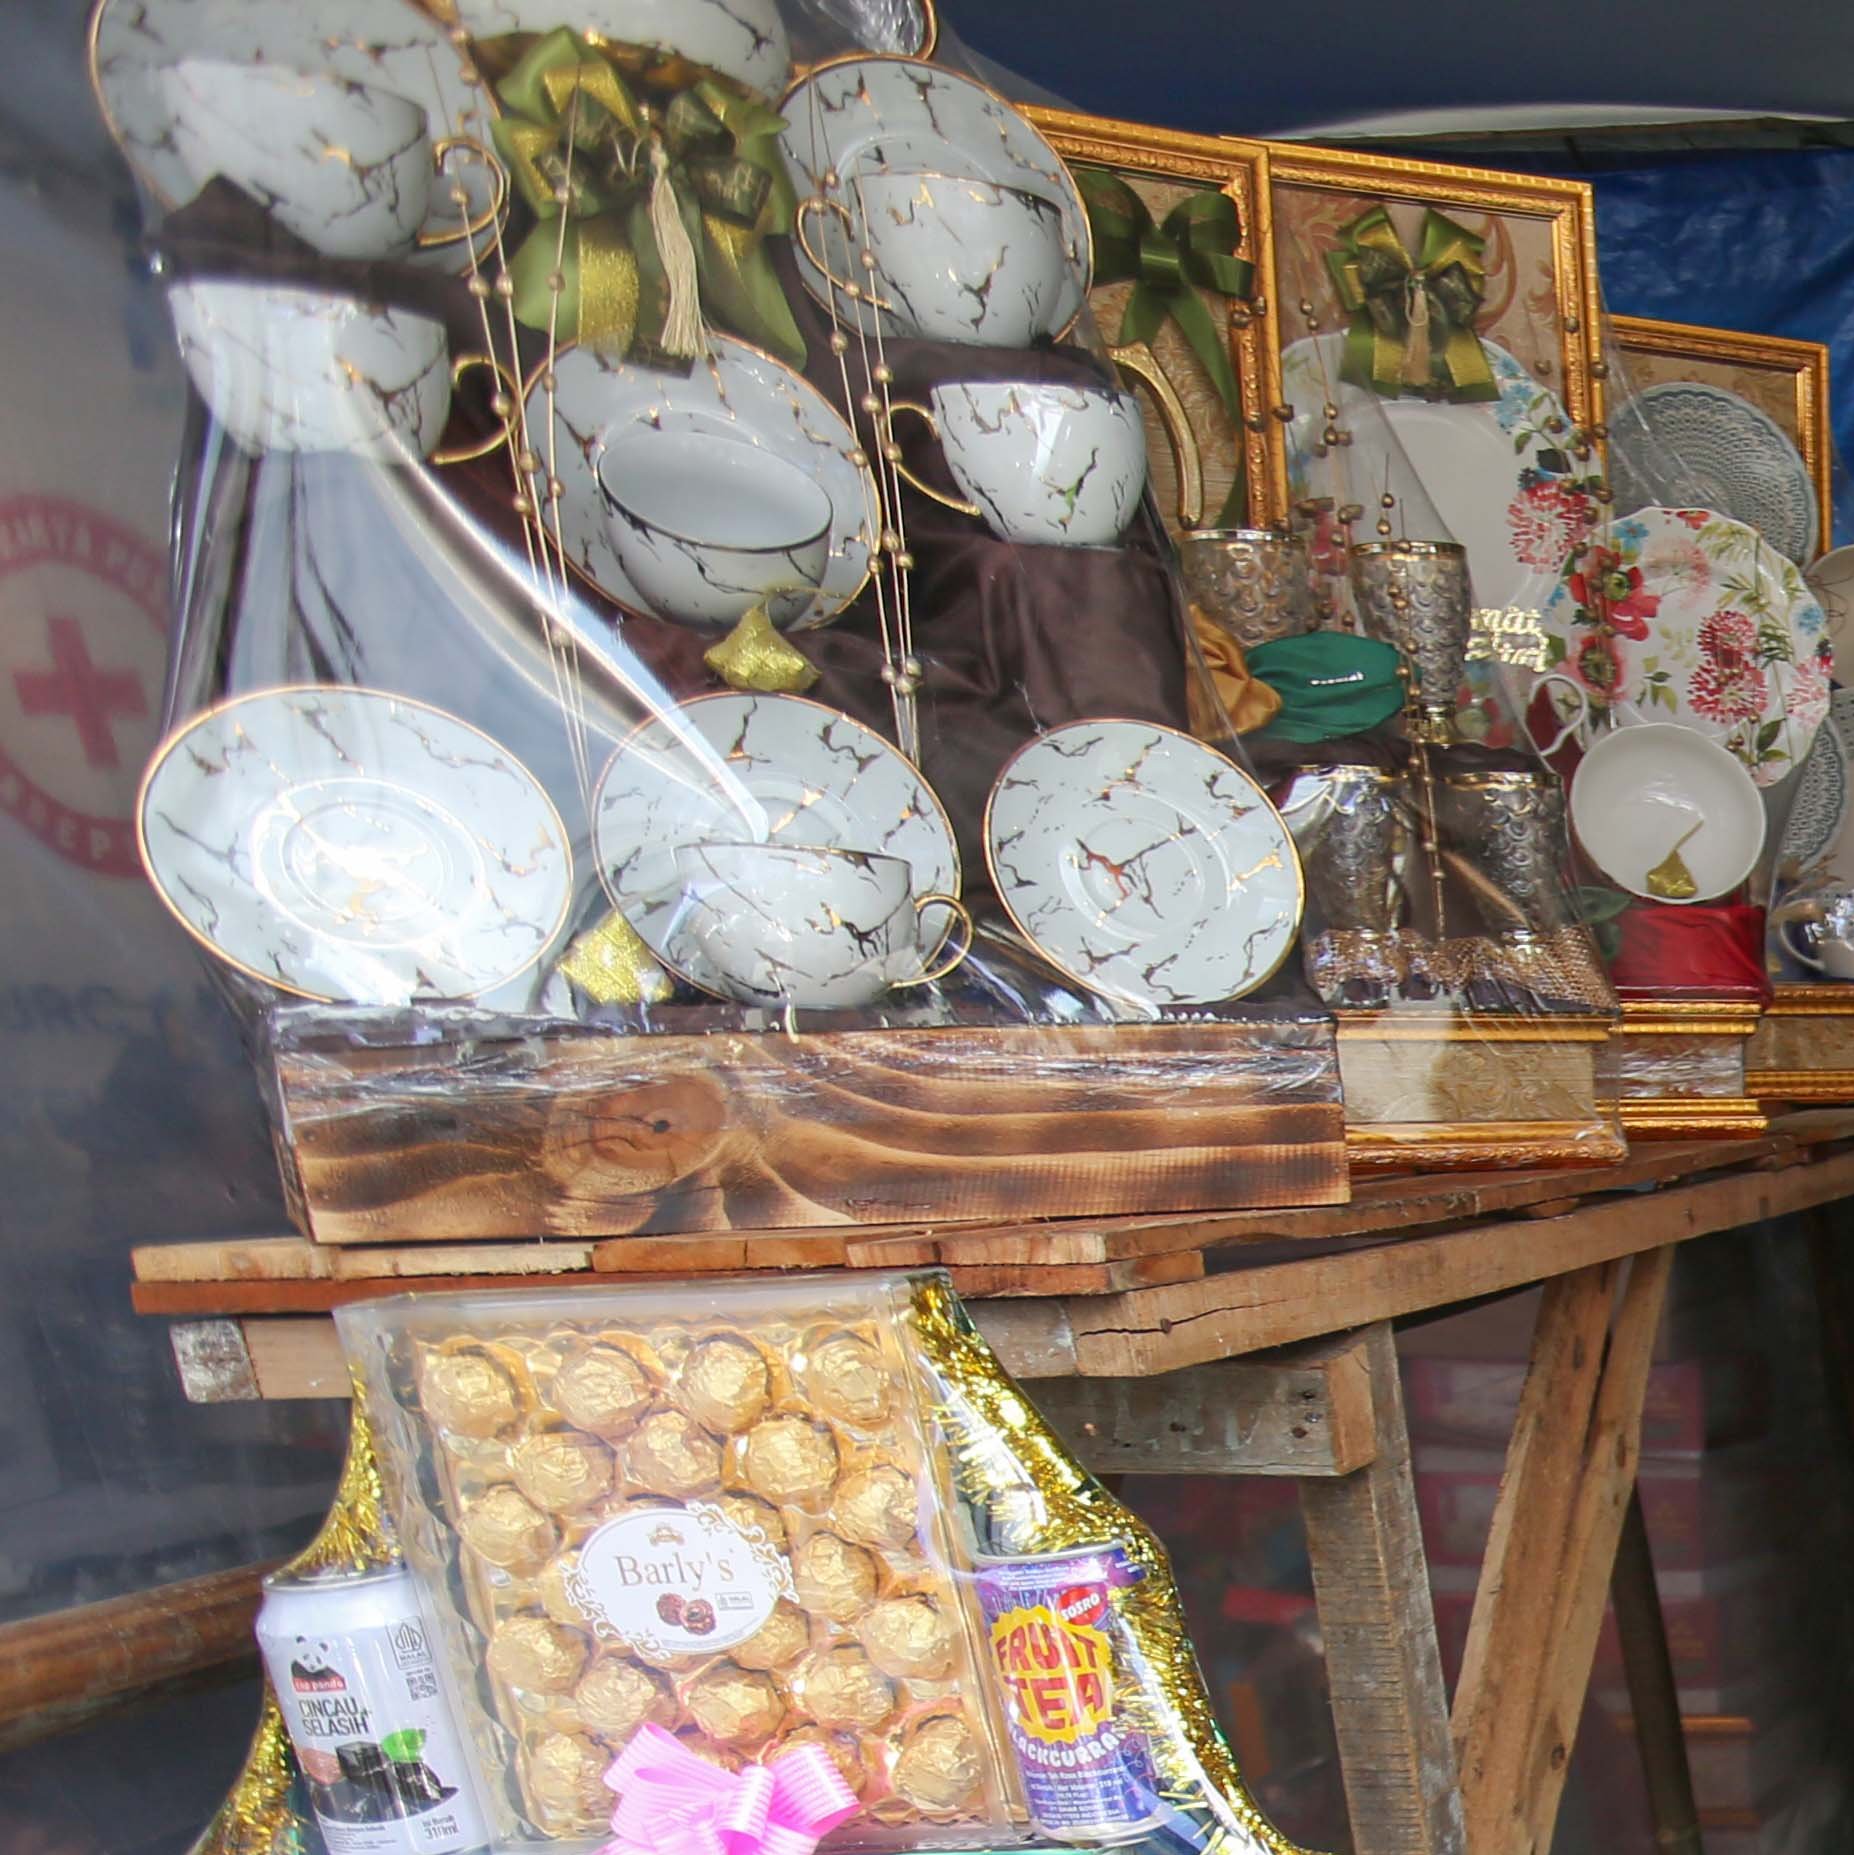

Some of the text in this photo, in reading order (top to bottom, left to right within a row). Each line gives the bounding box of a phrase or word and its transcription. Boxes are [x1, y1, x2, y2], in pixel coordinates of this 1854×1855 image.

[612, 1548, 738, 1592] Barly's
[1060, 1590, 1101, 1623] SOSRO
[993, 1619, 1099, 1673] FRUIT
[298, 1696, 359, 1720] CINCAU
[1003, 1672, 1105, 1730] TEA
